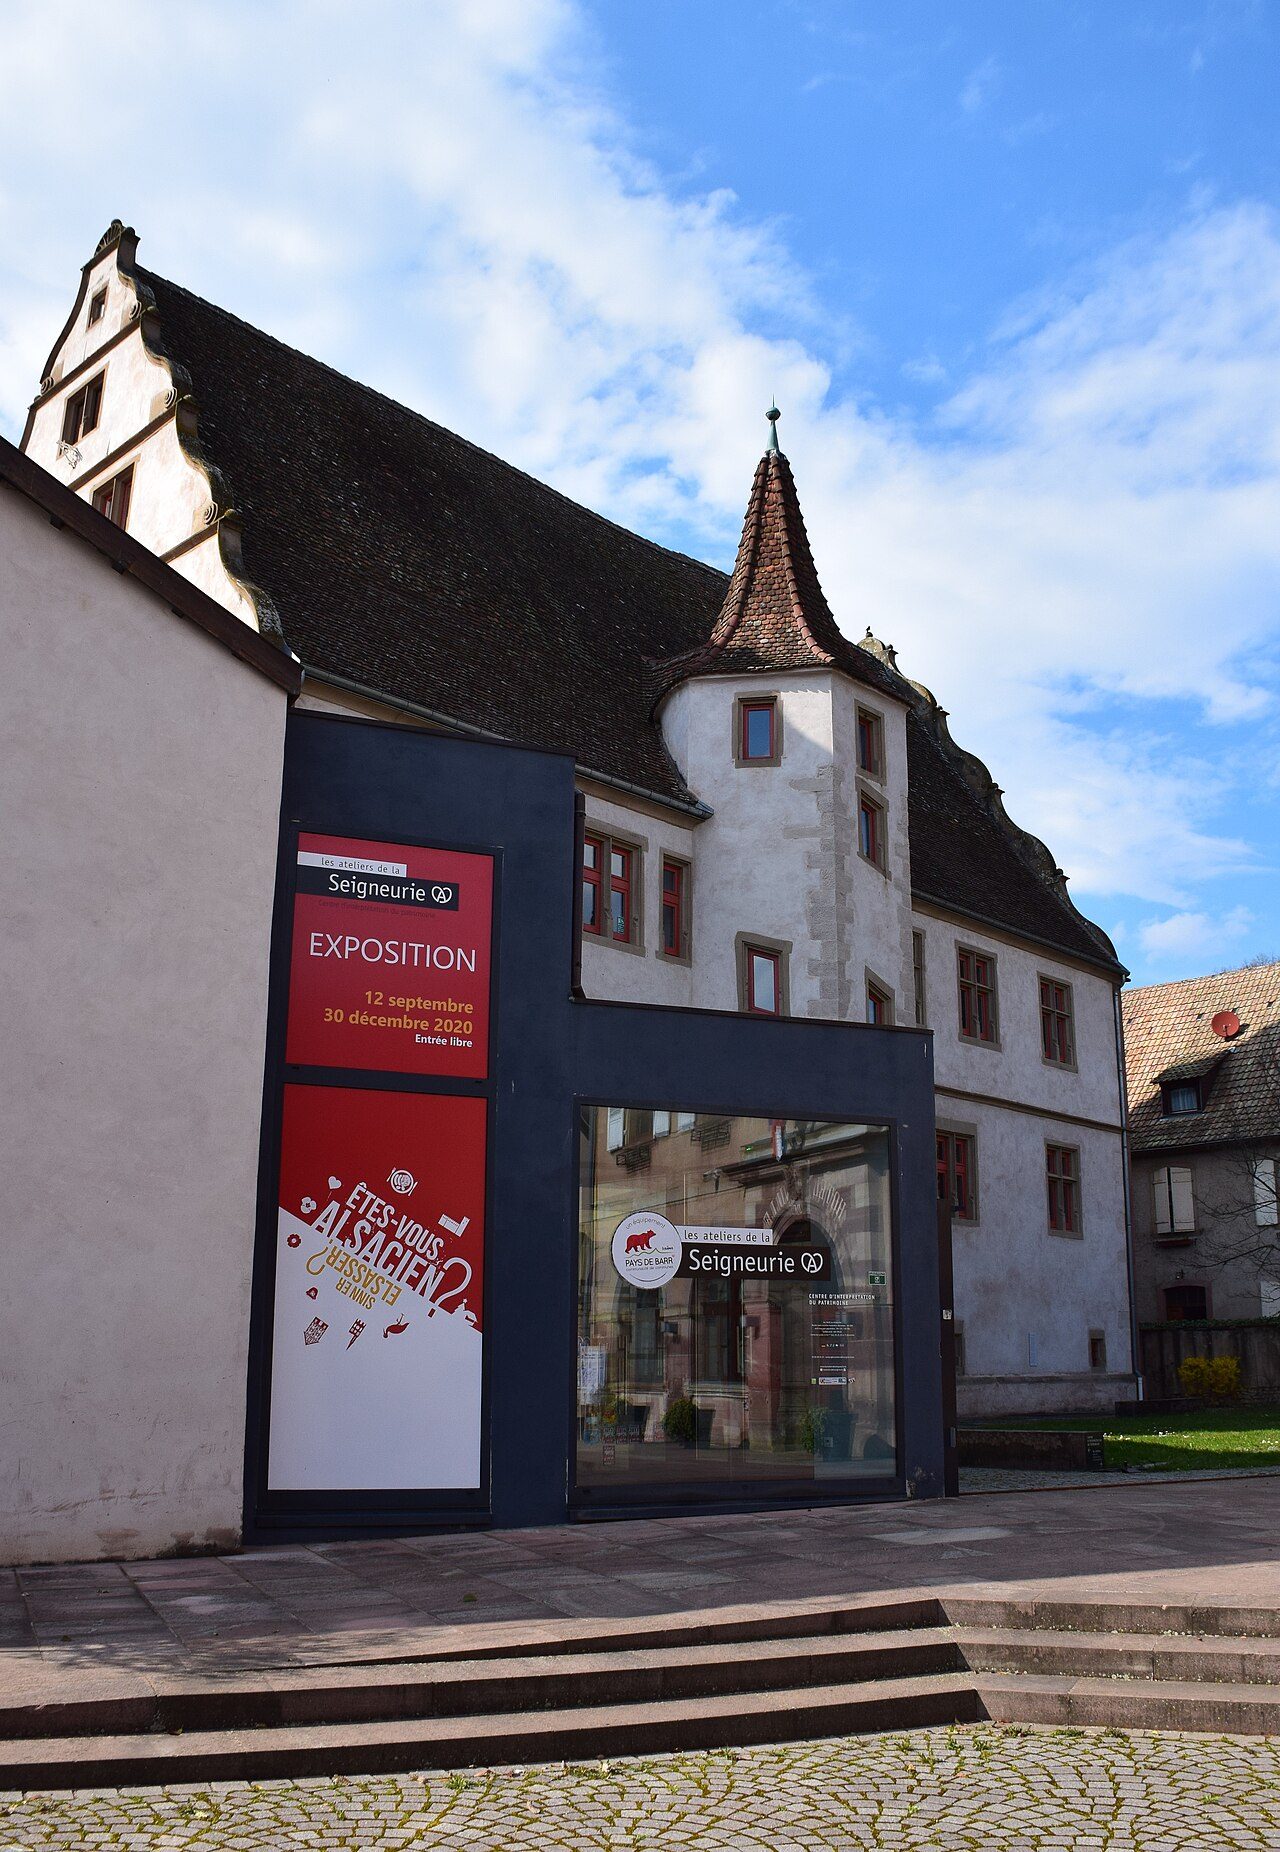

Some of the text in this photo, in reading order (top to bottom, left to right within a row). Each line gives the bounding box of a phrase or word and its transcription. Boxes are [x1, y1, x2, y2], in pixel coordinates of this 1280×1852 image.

[321, 857, 400, 875] les ateliers de la
[328, 874, 426, 901] Seigneurie
[309, 932, 476, 972] EXPOSITION
[365, 991, 474, 1014] 12 septembre
[324, 1008, 473, 1035] 30 décembre 2020
[415, 1034, 473, 1048] Entrée libre
[684, 1230, 770, 1243] les ateliers de la
[625, 1256, 673, 1267] PAYS DE BARR
[689, 1249, 795, 1277] Seigneurie
[335, 1277, 376, 1310] SINN ER
